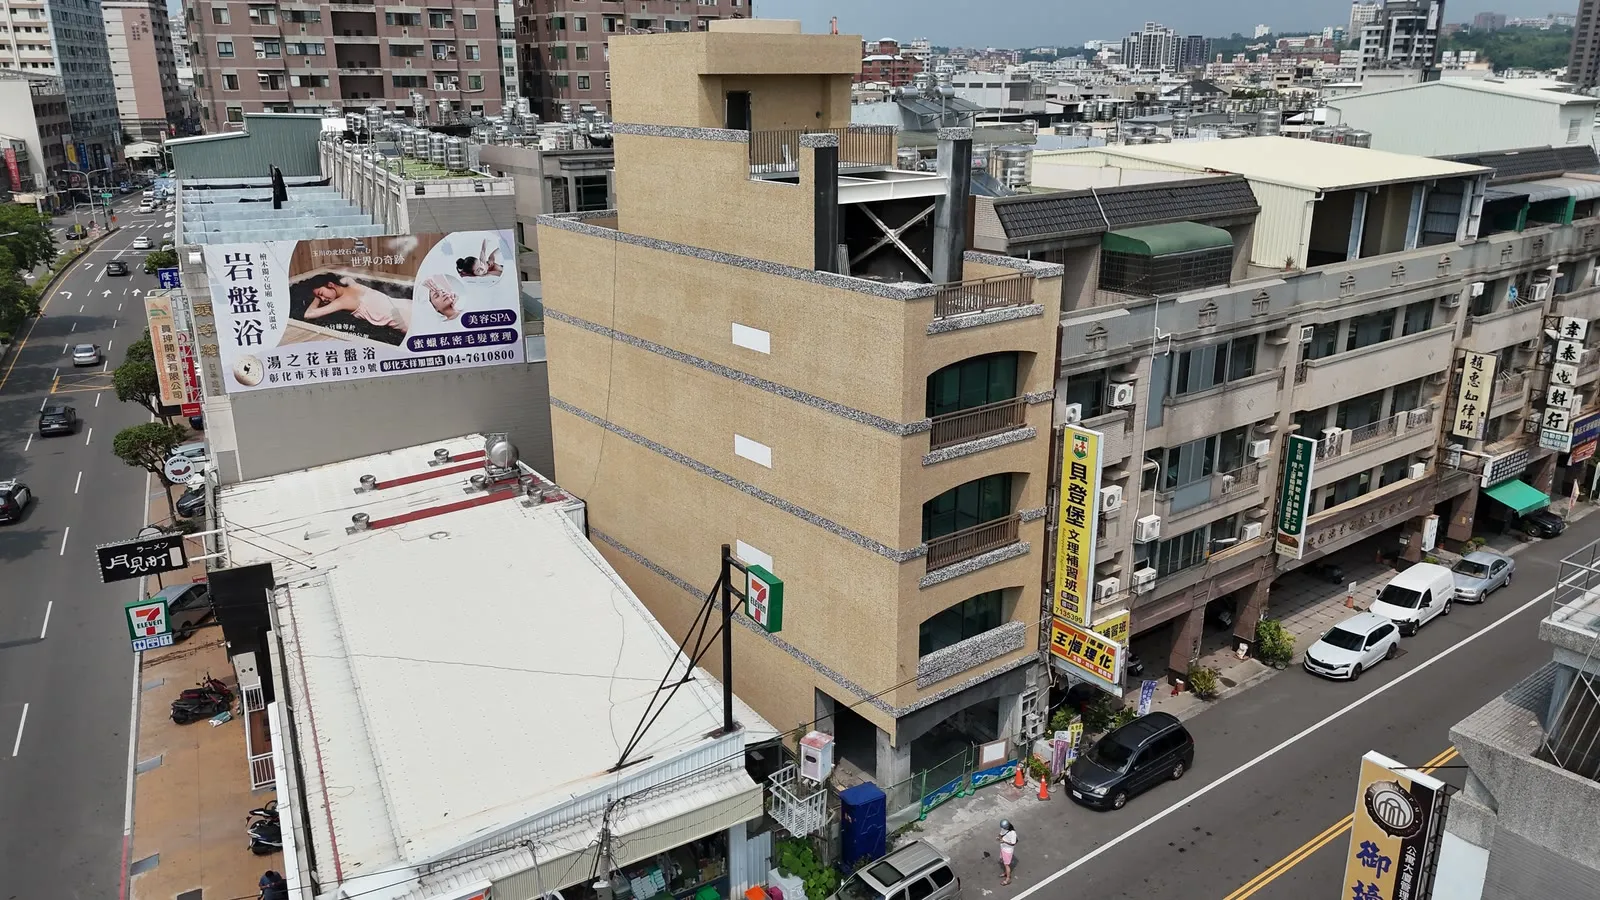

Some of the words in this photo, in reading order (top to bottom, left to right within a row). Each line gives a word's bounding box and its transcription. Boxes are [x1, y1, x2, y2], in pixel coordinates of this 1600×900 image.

[351, 254, 405, 267] 世界の奇跡
[224, 252, 264, 347] 岩盤浴
[469, 313, 512, 325] 美容SPA
[413, 331, 512, 349] 蜜蠟私密毛髮整理
[267, 346, 376, 370] 湯之花岩盤浴
[382, 356, 445, 371] 彰化天祥加盟店
[447, 350, 515, 365] 04-7610800
[269, 363, 378, 383] 彰化市天祥路129號
[1065, 461, 1088, 529] 貝登堡
[136, 542, 169, 553] ラーメン
[105, 553, 168, 574] 月見町
[1064, 528, 1081, 593] 文理補習班
[750, 596, 766, 614] ELEVEN
[136, 619, 162, 629] ELEVEN
[1055, 606, 1083, 624] 7135399
